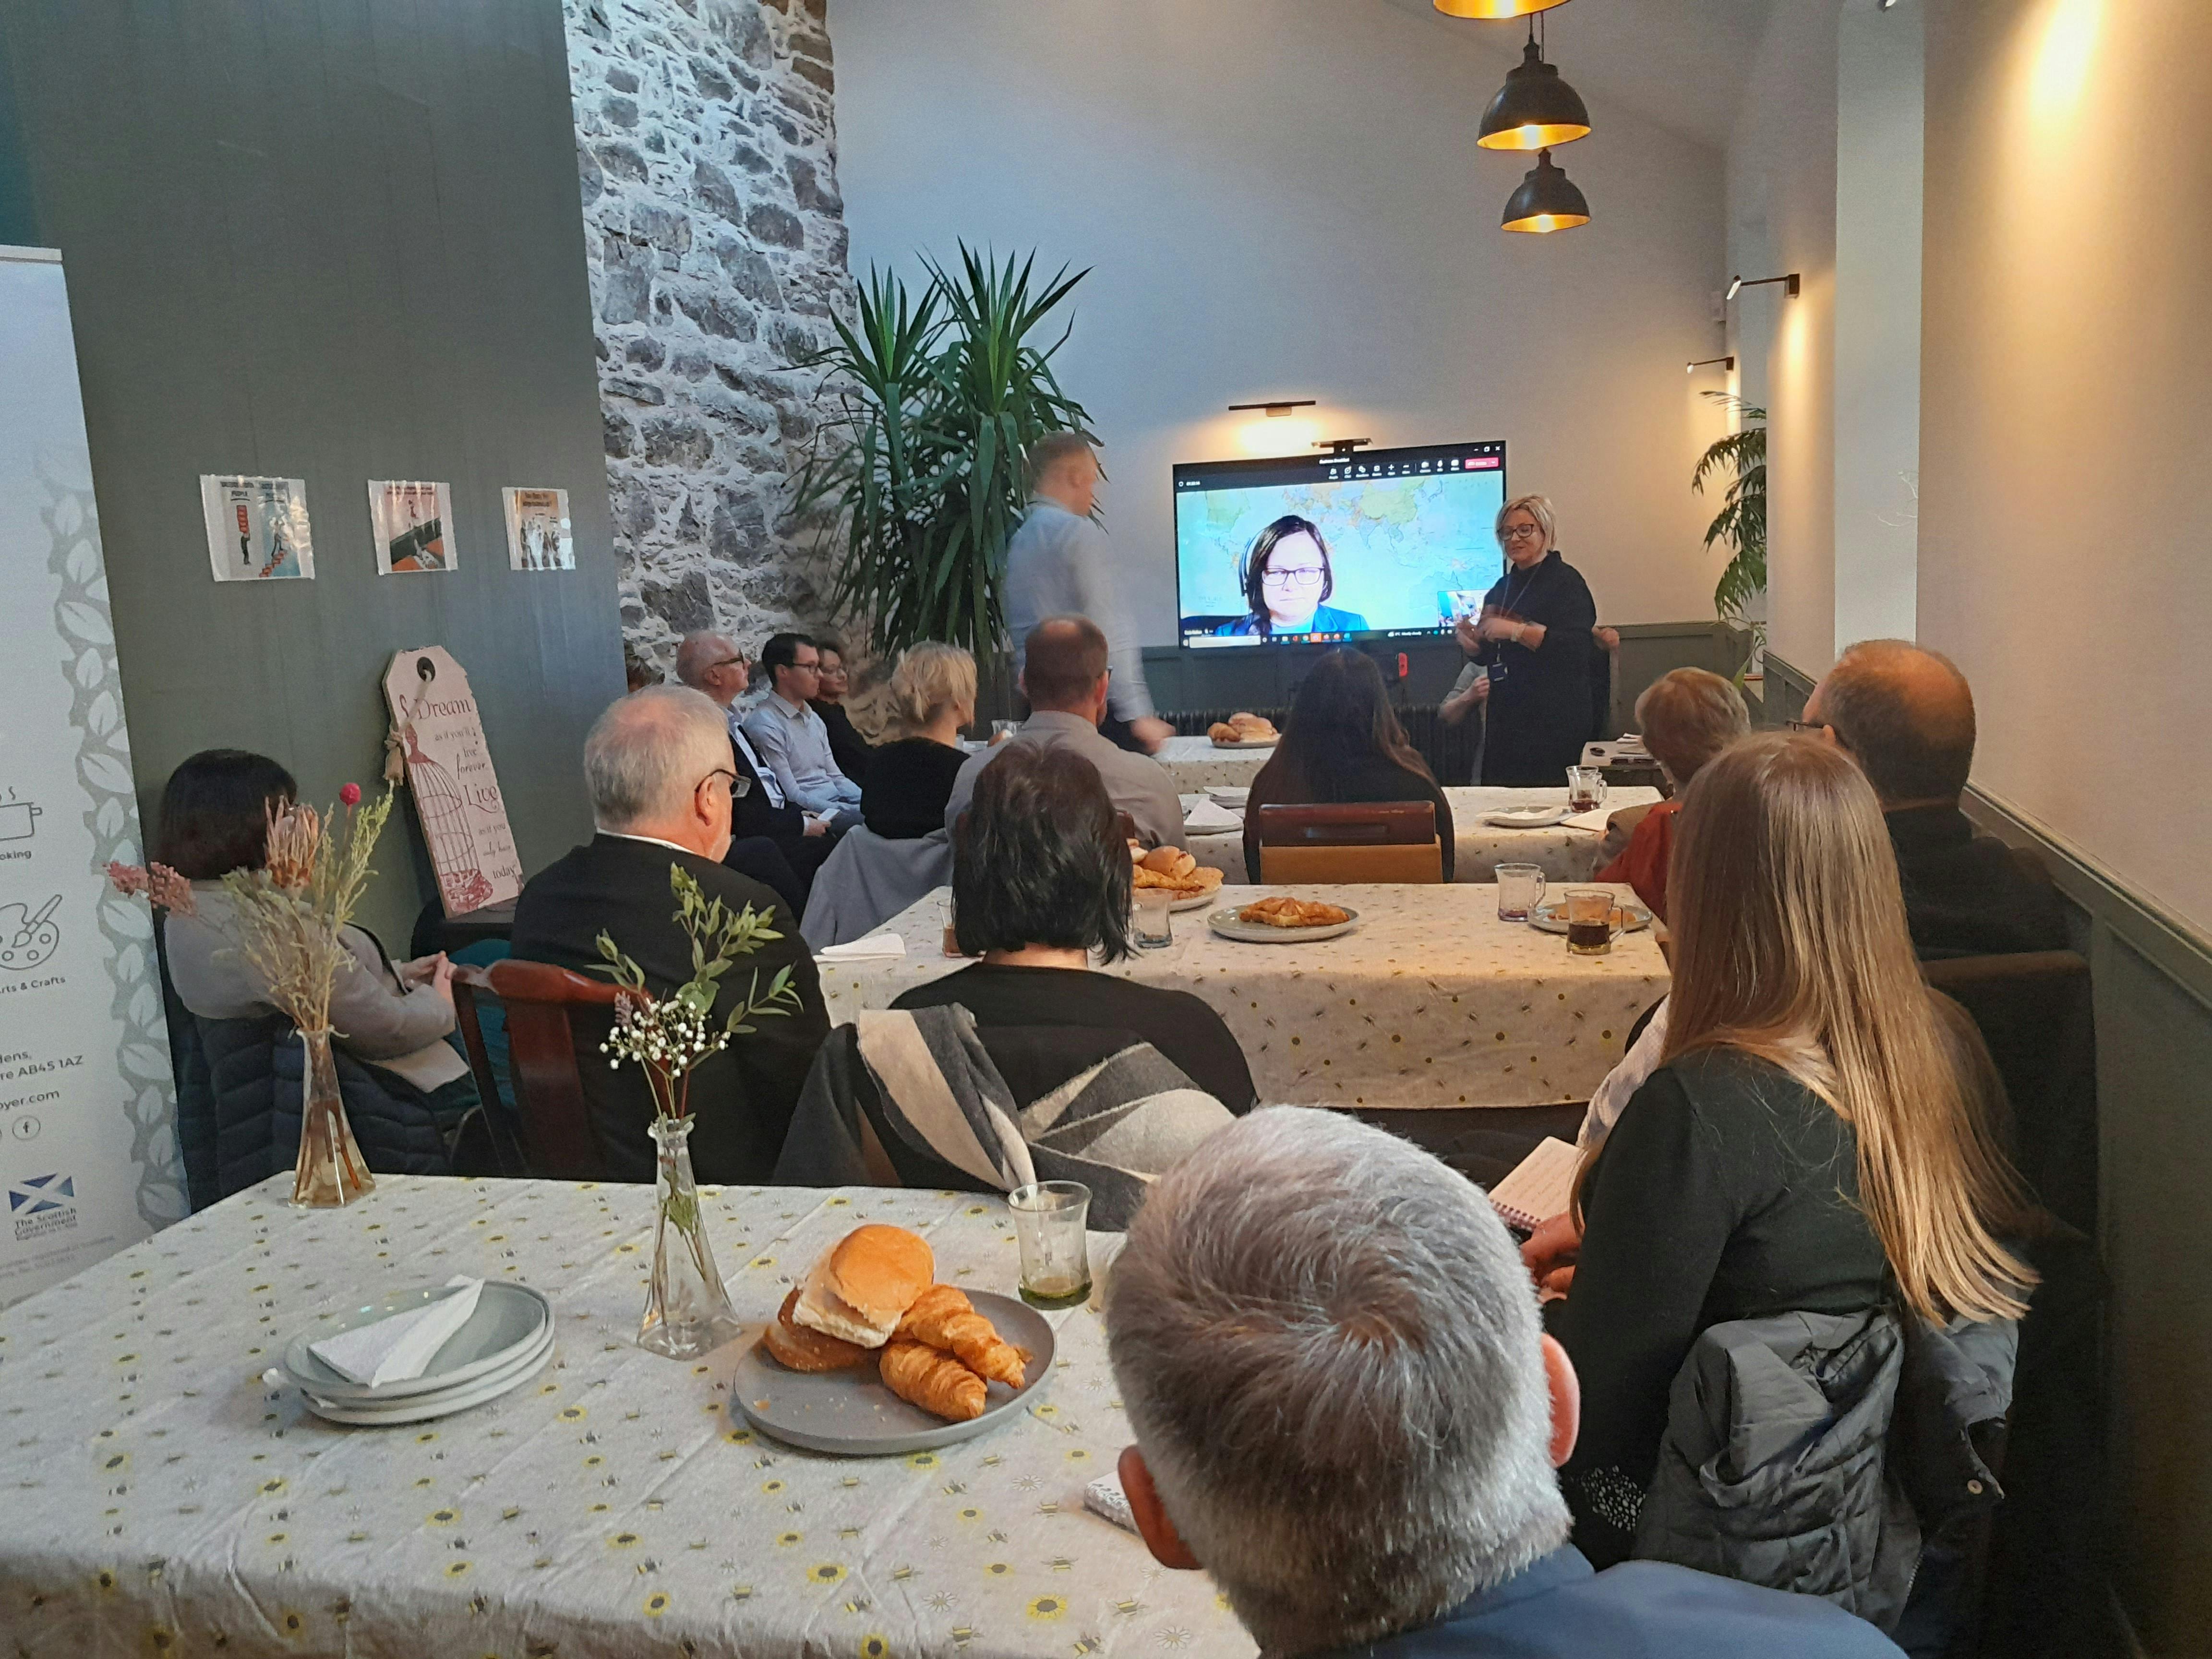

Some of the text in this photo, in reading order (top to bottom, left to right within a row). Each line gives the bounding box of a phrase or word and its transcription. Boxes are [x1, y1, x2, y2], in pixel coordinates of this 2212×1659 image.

[413, 698, 471, 720] Dream
[463, 747, 477, 757] live
[457, 753, 485, 781] forever
[463, 784, 500, 814] Live
[492, 865, 516, 879] today
[0, 976, 66, 994] rts & Crafts
[18, 1060, 55, 1078] AB45
[59, 1055, 84, 1069] 1AZ
[15, 1218, 33, 1228] The
